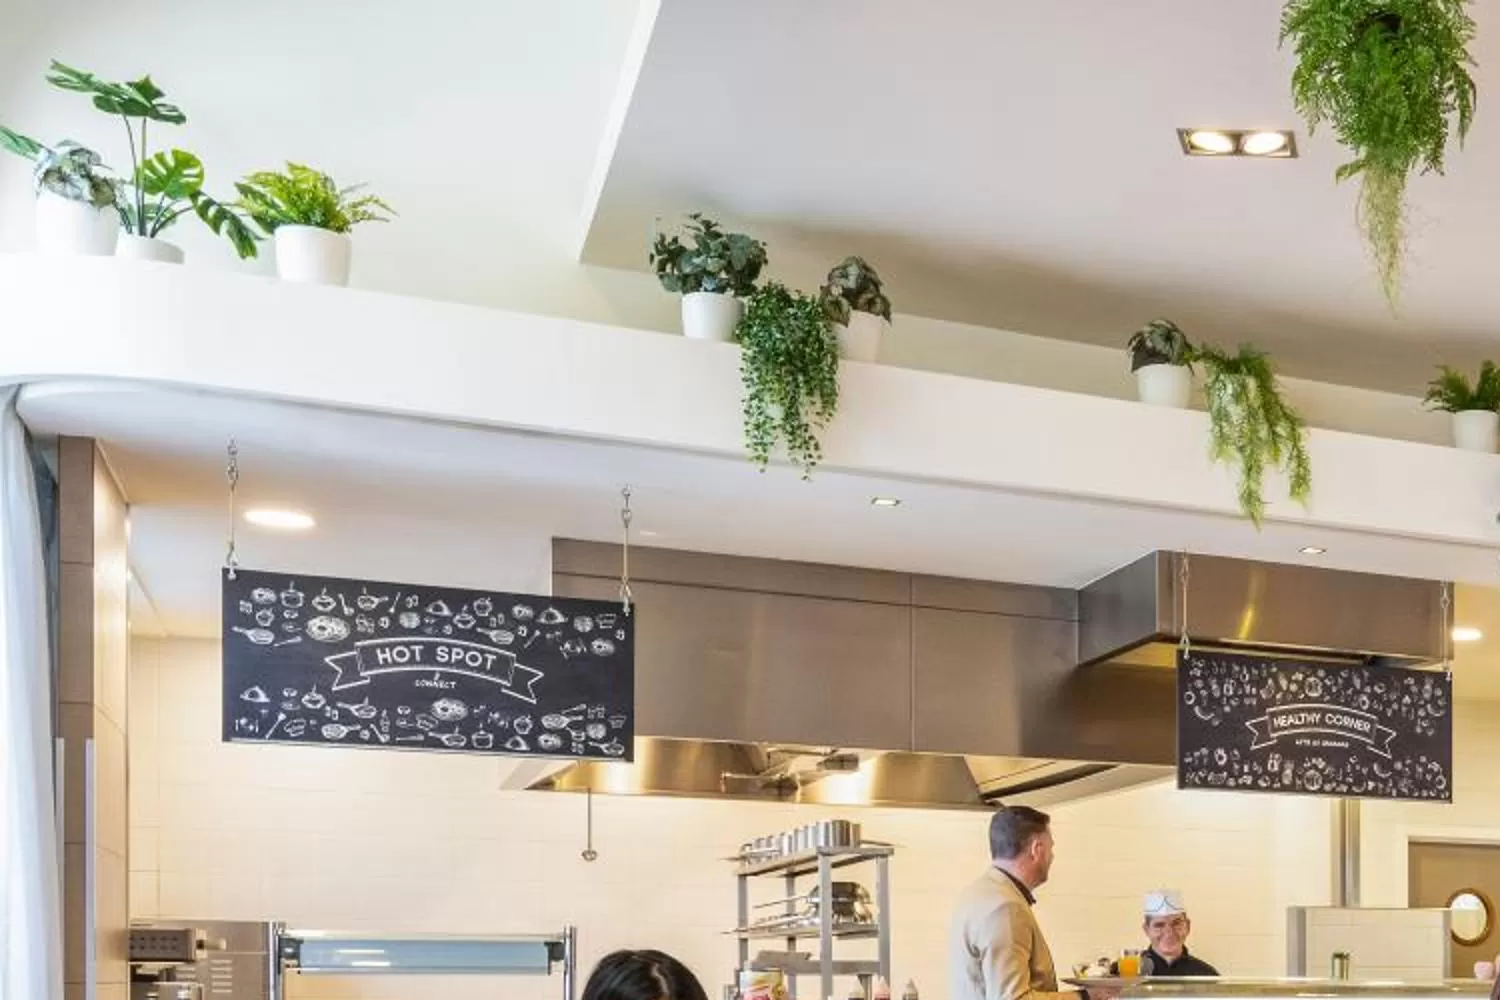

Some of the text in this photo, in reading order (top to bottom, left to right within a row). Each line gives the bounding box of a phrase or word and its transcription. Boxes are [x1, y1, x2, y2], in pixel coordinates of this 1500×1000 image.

[376, 645, 497, 671] HOT SPOT
[1273, 712, 1371, 732] HEALTHY CORNER
